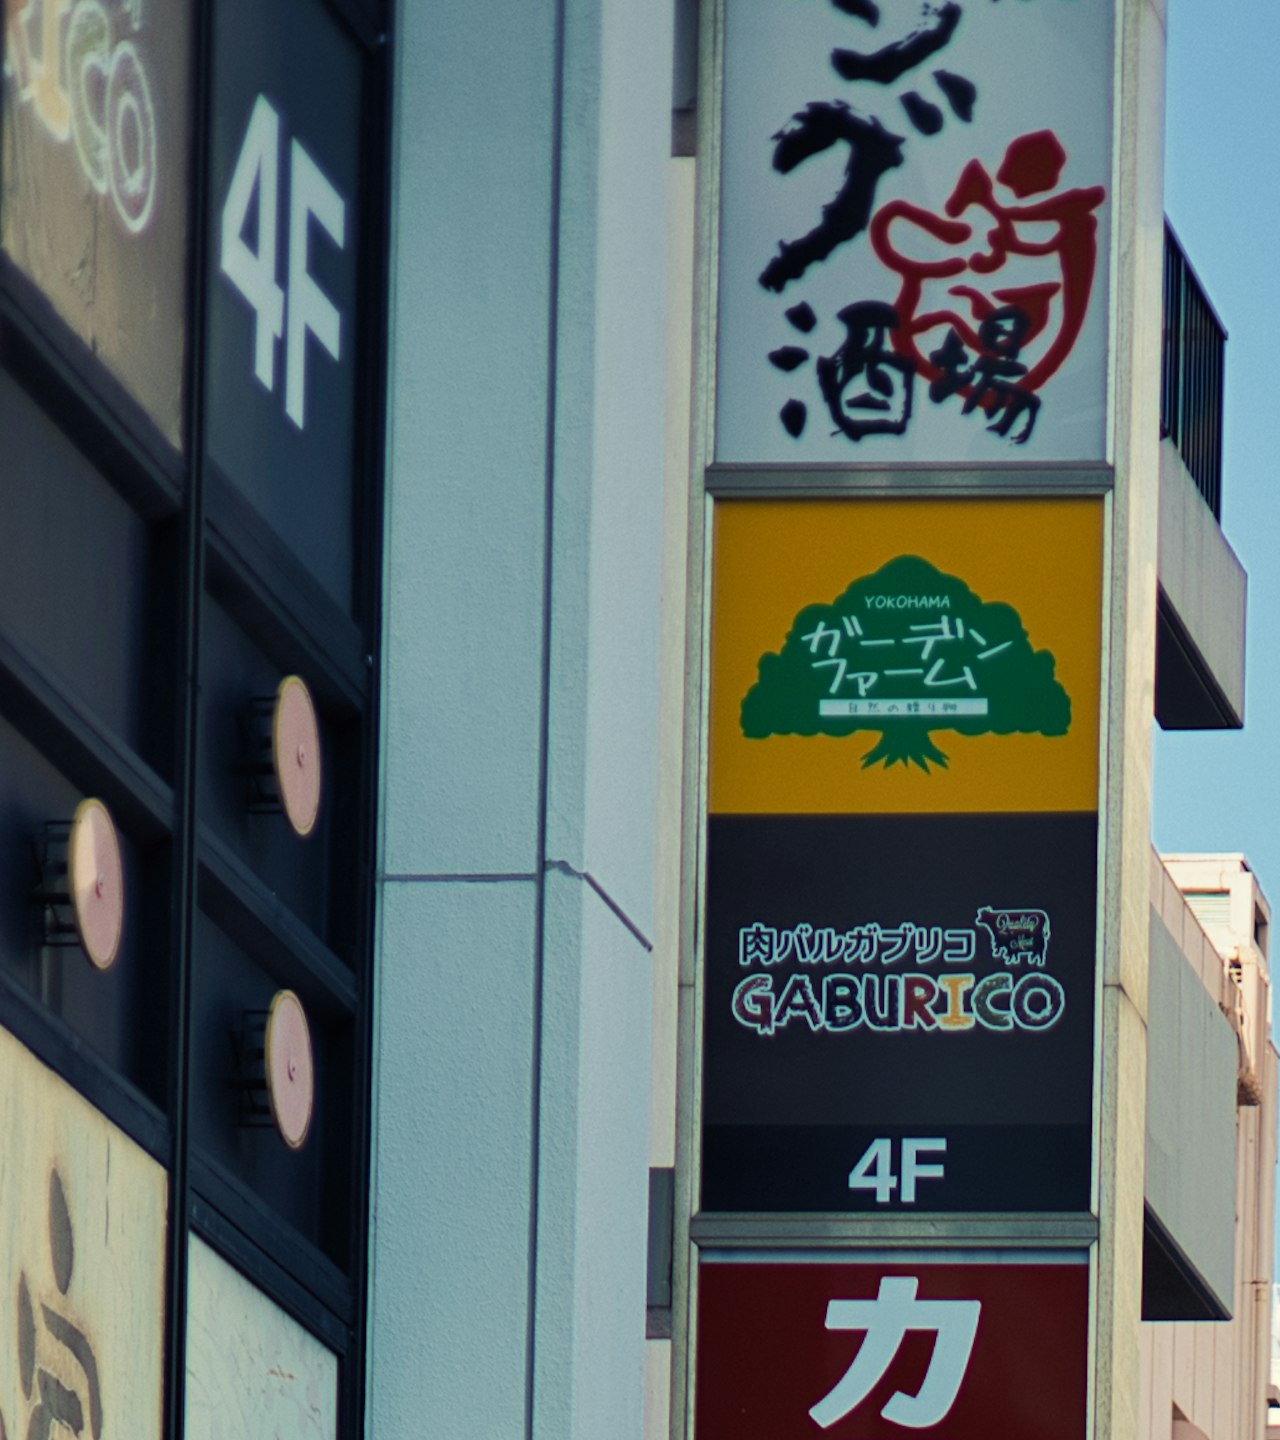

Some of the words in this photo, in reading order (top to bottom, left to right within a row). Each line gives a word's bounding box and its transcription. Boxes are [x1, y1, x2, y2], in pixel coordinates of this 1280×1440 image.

[222, 94, 345, 430] 4F
[767, 300, 1042, 445] 酒場
[865, 595, 950, 609] YOKOHAMA
[801, 614, 1013, 661] ガーデン
[811, 658, 977, 697] ファーム
[739, 922, 976, 966] 肉バルガブリコ
[732, 972, 1066, 1036] GABURICO
[848, 1137, 948, 1203] 4F
